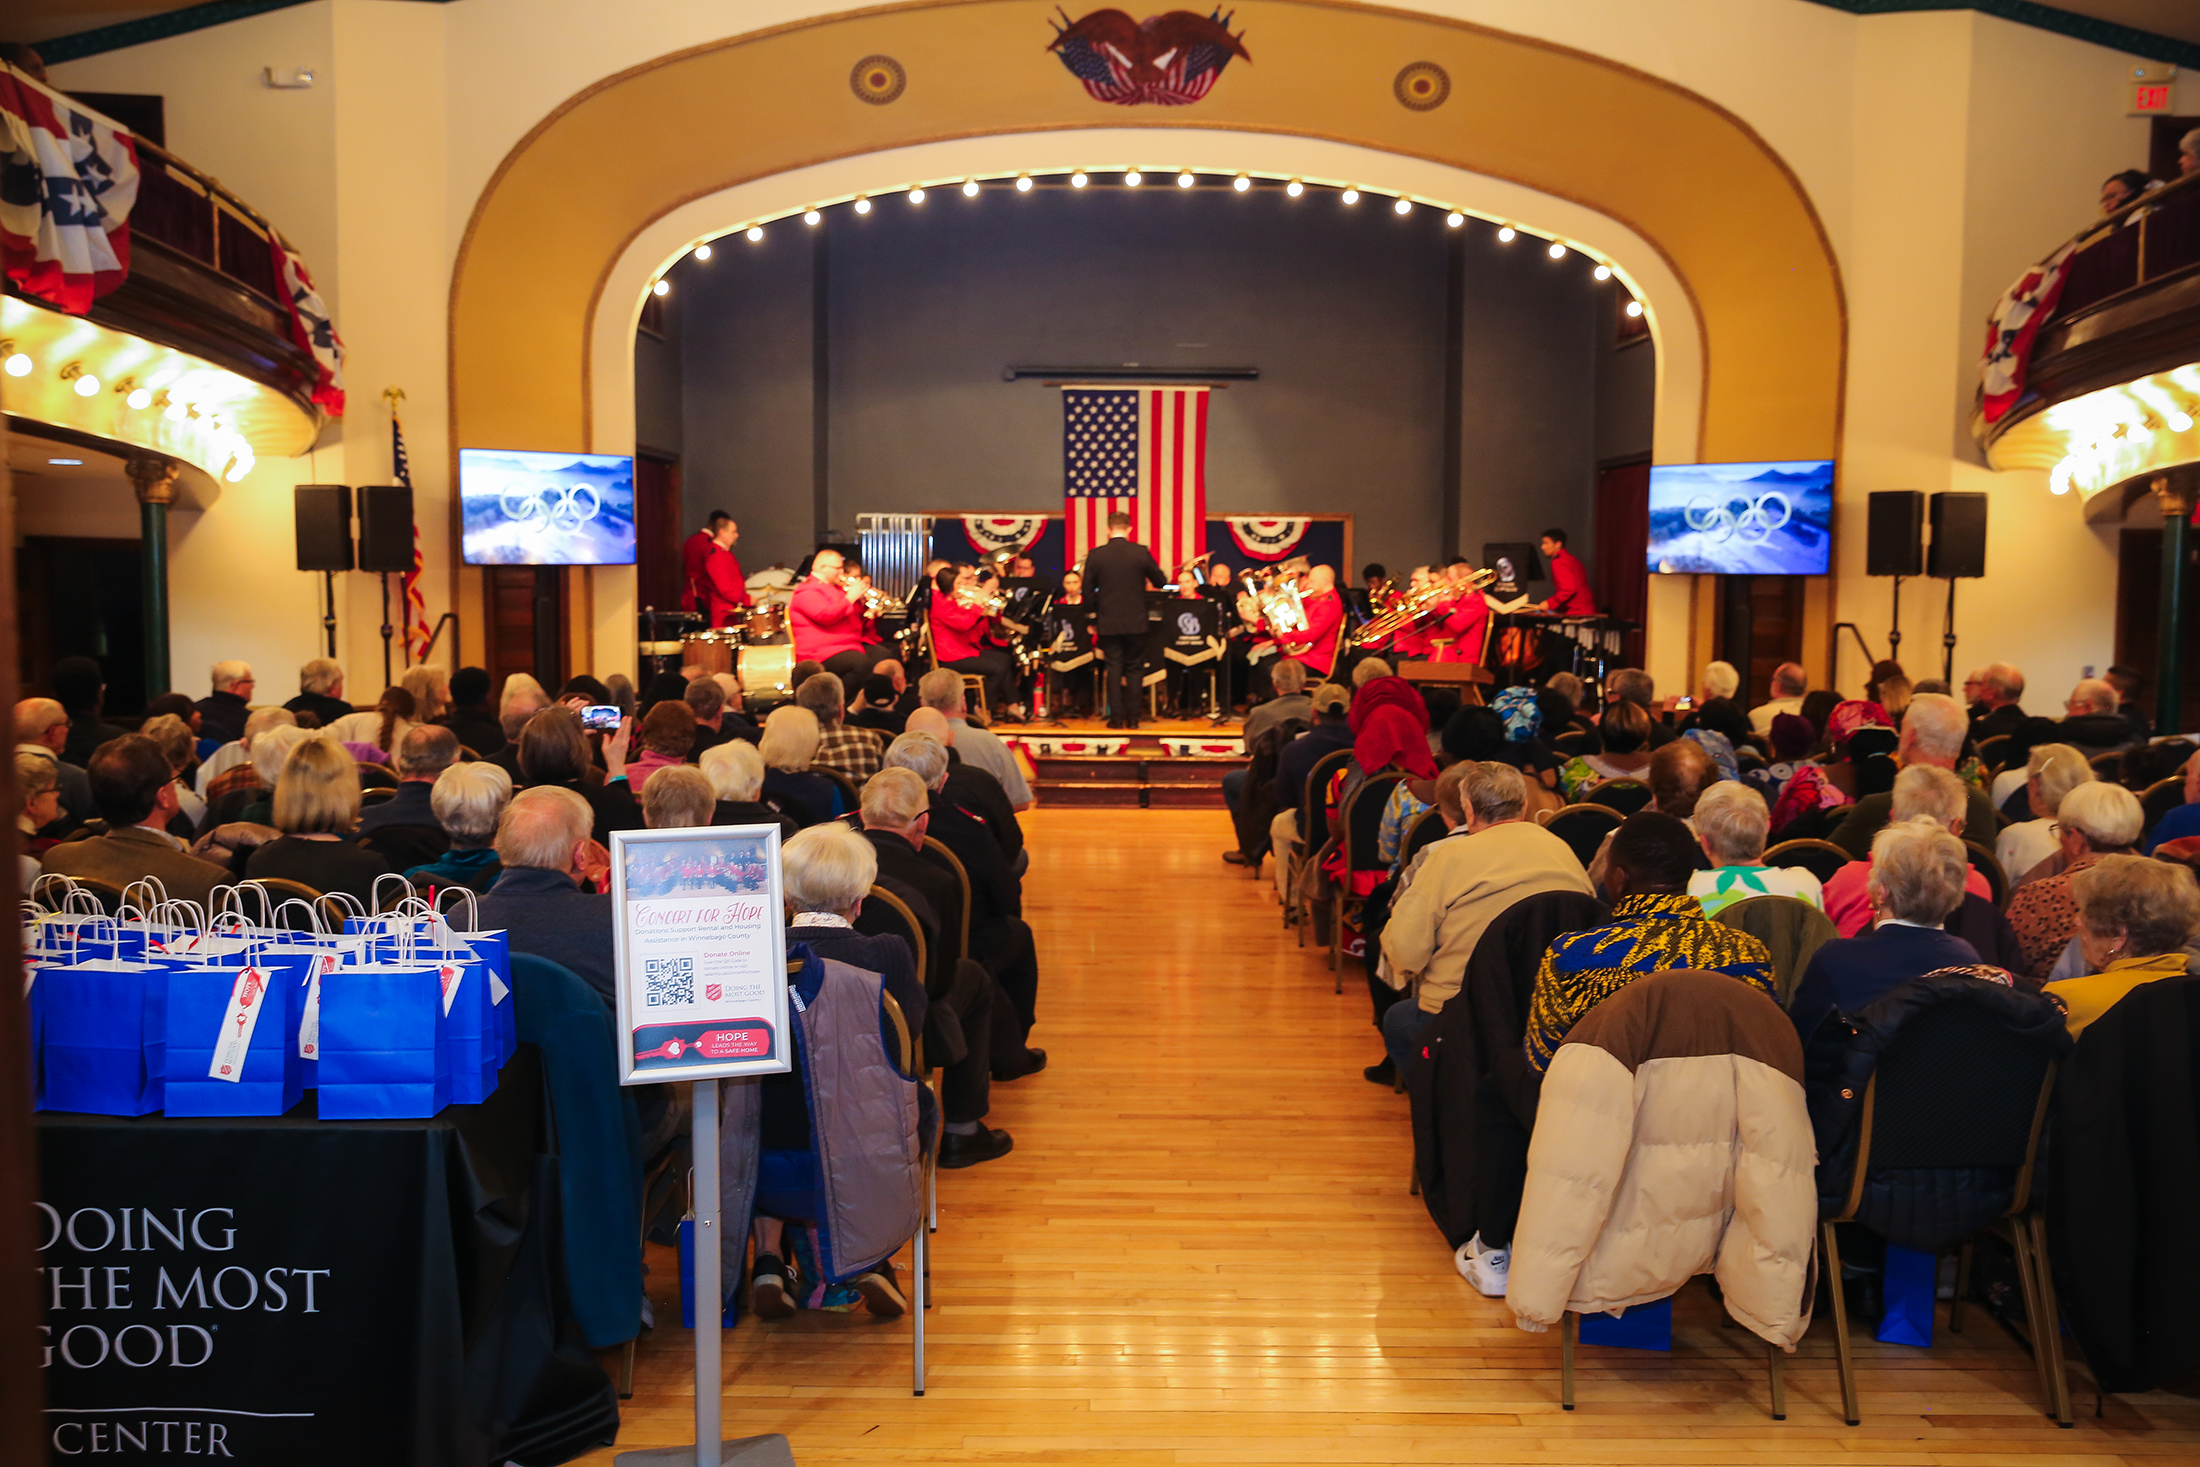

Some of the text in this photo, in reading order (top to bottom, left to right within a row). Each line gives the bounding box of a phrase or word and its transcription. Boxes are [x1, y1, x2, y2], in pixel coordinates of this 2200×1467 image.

[2136, 86, 2168, 110] EXIT
[635, 901, 764, 928] CONCERT FOR HOPE
[670, 926, 697, 934] Support
[717, 1032, 749, 1042] HOPE
[34, 1265, 331, 1314] HE MOST
[53, 1420, 235, 1458] CENTER
